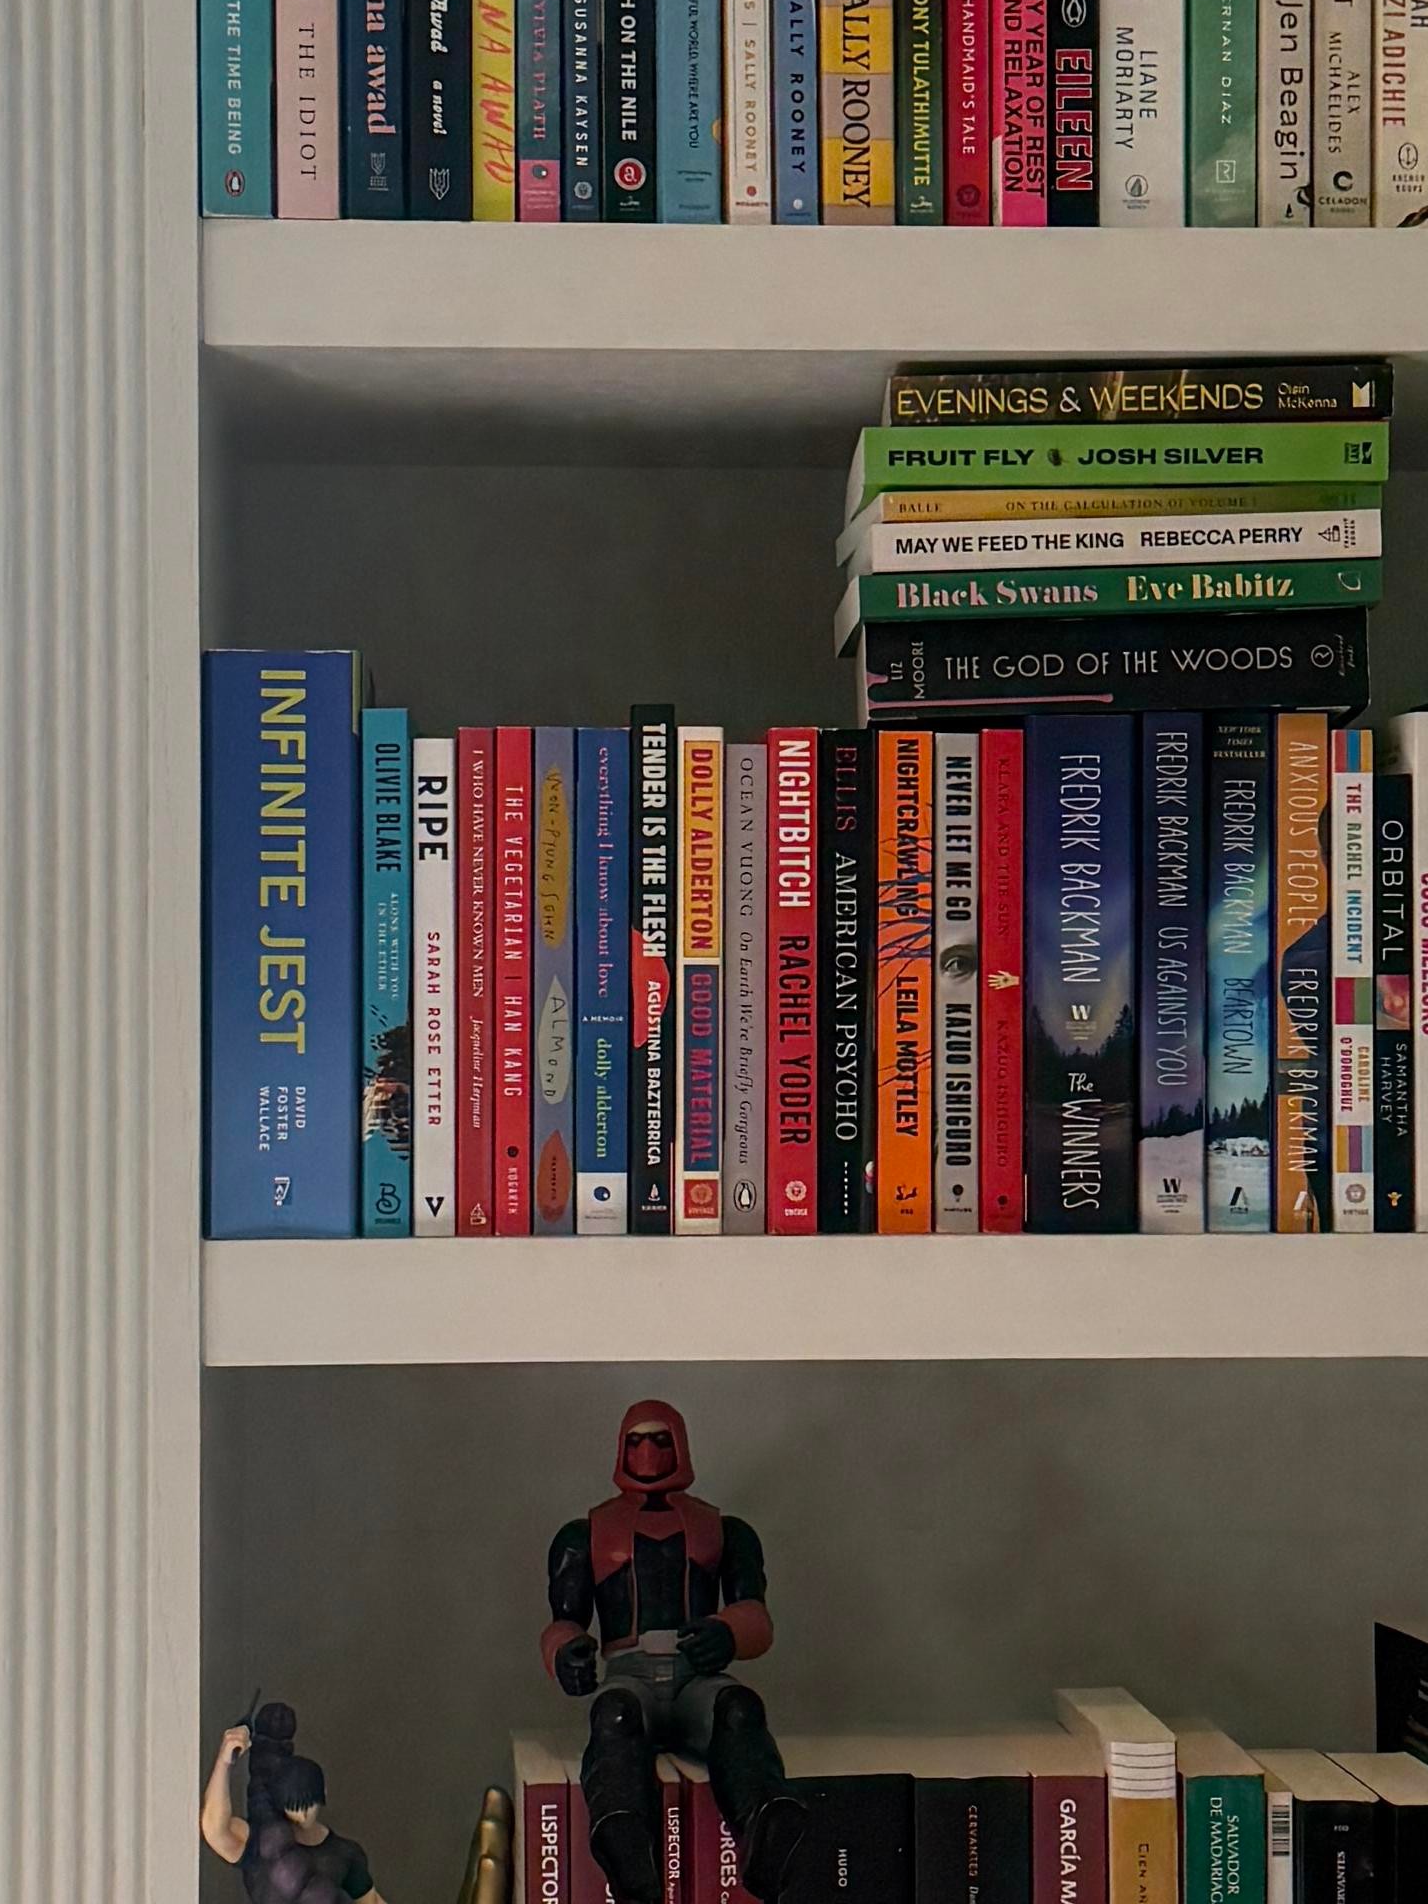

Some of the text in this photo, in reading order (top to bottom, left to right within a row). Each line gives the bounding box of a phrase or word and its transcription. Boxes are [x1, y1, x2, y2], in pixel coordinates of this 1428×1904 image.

[299, 23, 316, 80] THE
[622, 19, 636, 43] ON
[1276, 0, 1301, 59] Jen
[367, 44, 394, 134] awad
[622, 51, 636, 89] THE
[300, 95, 316, 182] IDIOT
[575, 95, 588, 167] KAYSEN
[622, 97, 636, 141] NILE
[914, 41, 930, 185] TULATHIMUTTE
[1055, 48, 1093, 191] EILEEN
[1276, 67, 1304, 180] Beagin
[897, 383, 1263, 415] EVENINGS & WEEKENDS
[889, 447, 1263, 466] FRUIT FLY JOSH SILVER
[945, 646, 1293, 680] THE GOD OF THE WOODS
[259, 670, 307, 1054] INFINITE JEST
[642, 723, 667, 957] TENDER IS THE FLESH
[1060, 755, 1100, 982] FREDRIK BACKMAN
[418, 775, 448, 1127] RIPE SARAH ROSE ETTER
[777, 739, 812, 1145] NIGHTBITCH RACHEL YODER
[259, 1086, 270, 1151] WALLACE
[277, 1086, 288, 1140] FOSTER
[295, 1086, 306, 1128] DAVID
[1062, 1100, 1100, 1209] WINNERS
[1059, 1799, 1079, 1875] GARCÍA
